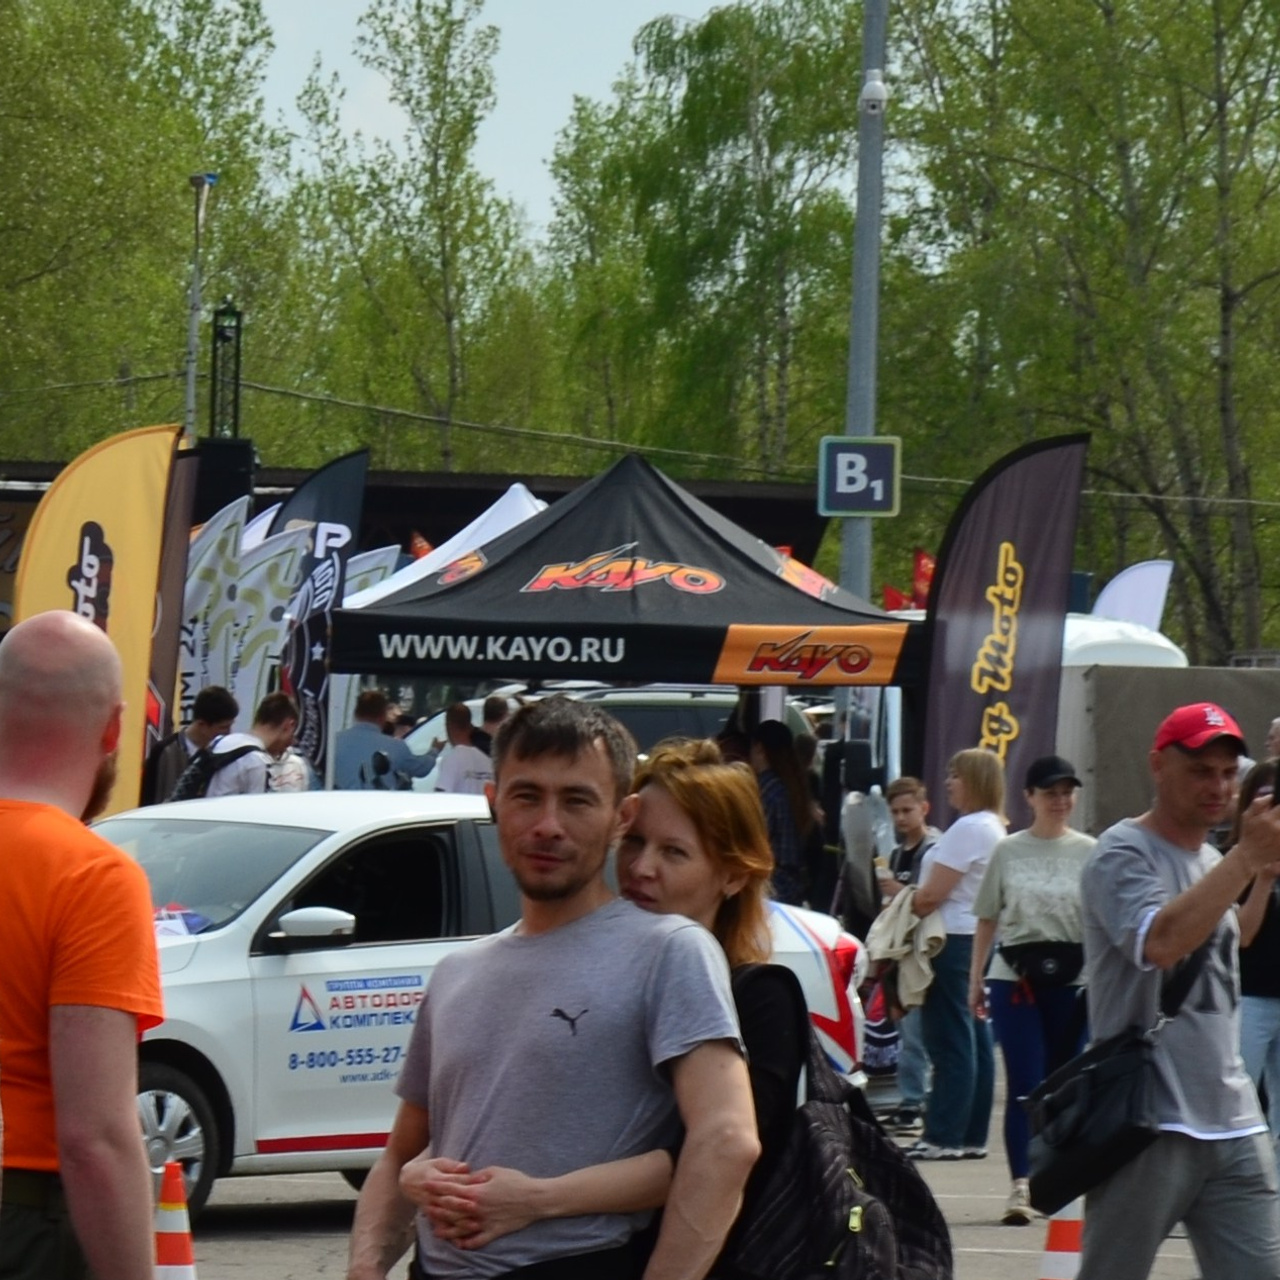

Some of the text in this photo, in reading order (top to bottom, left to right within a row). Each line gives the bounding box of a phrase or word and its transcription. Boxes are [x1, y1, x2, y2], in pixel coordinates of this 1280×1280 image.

[520, 541, 727, 595] KAYO
[378, 633, 625, 663] WWW.KAYO.RU
[747, 630, 873, 680] KAYO
[329, 1010, 415, 1029] КОМПЛЕК
[288, 1046, 407, 1070] 8-800-555-27-
